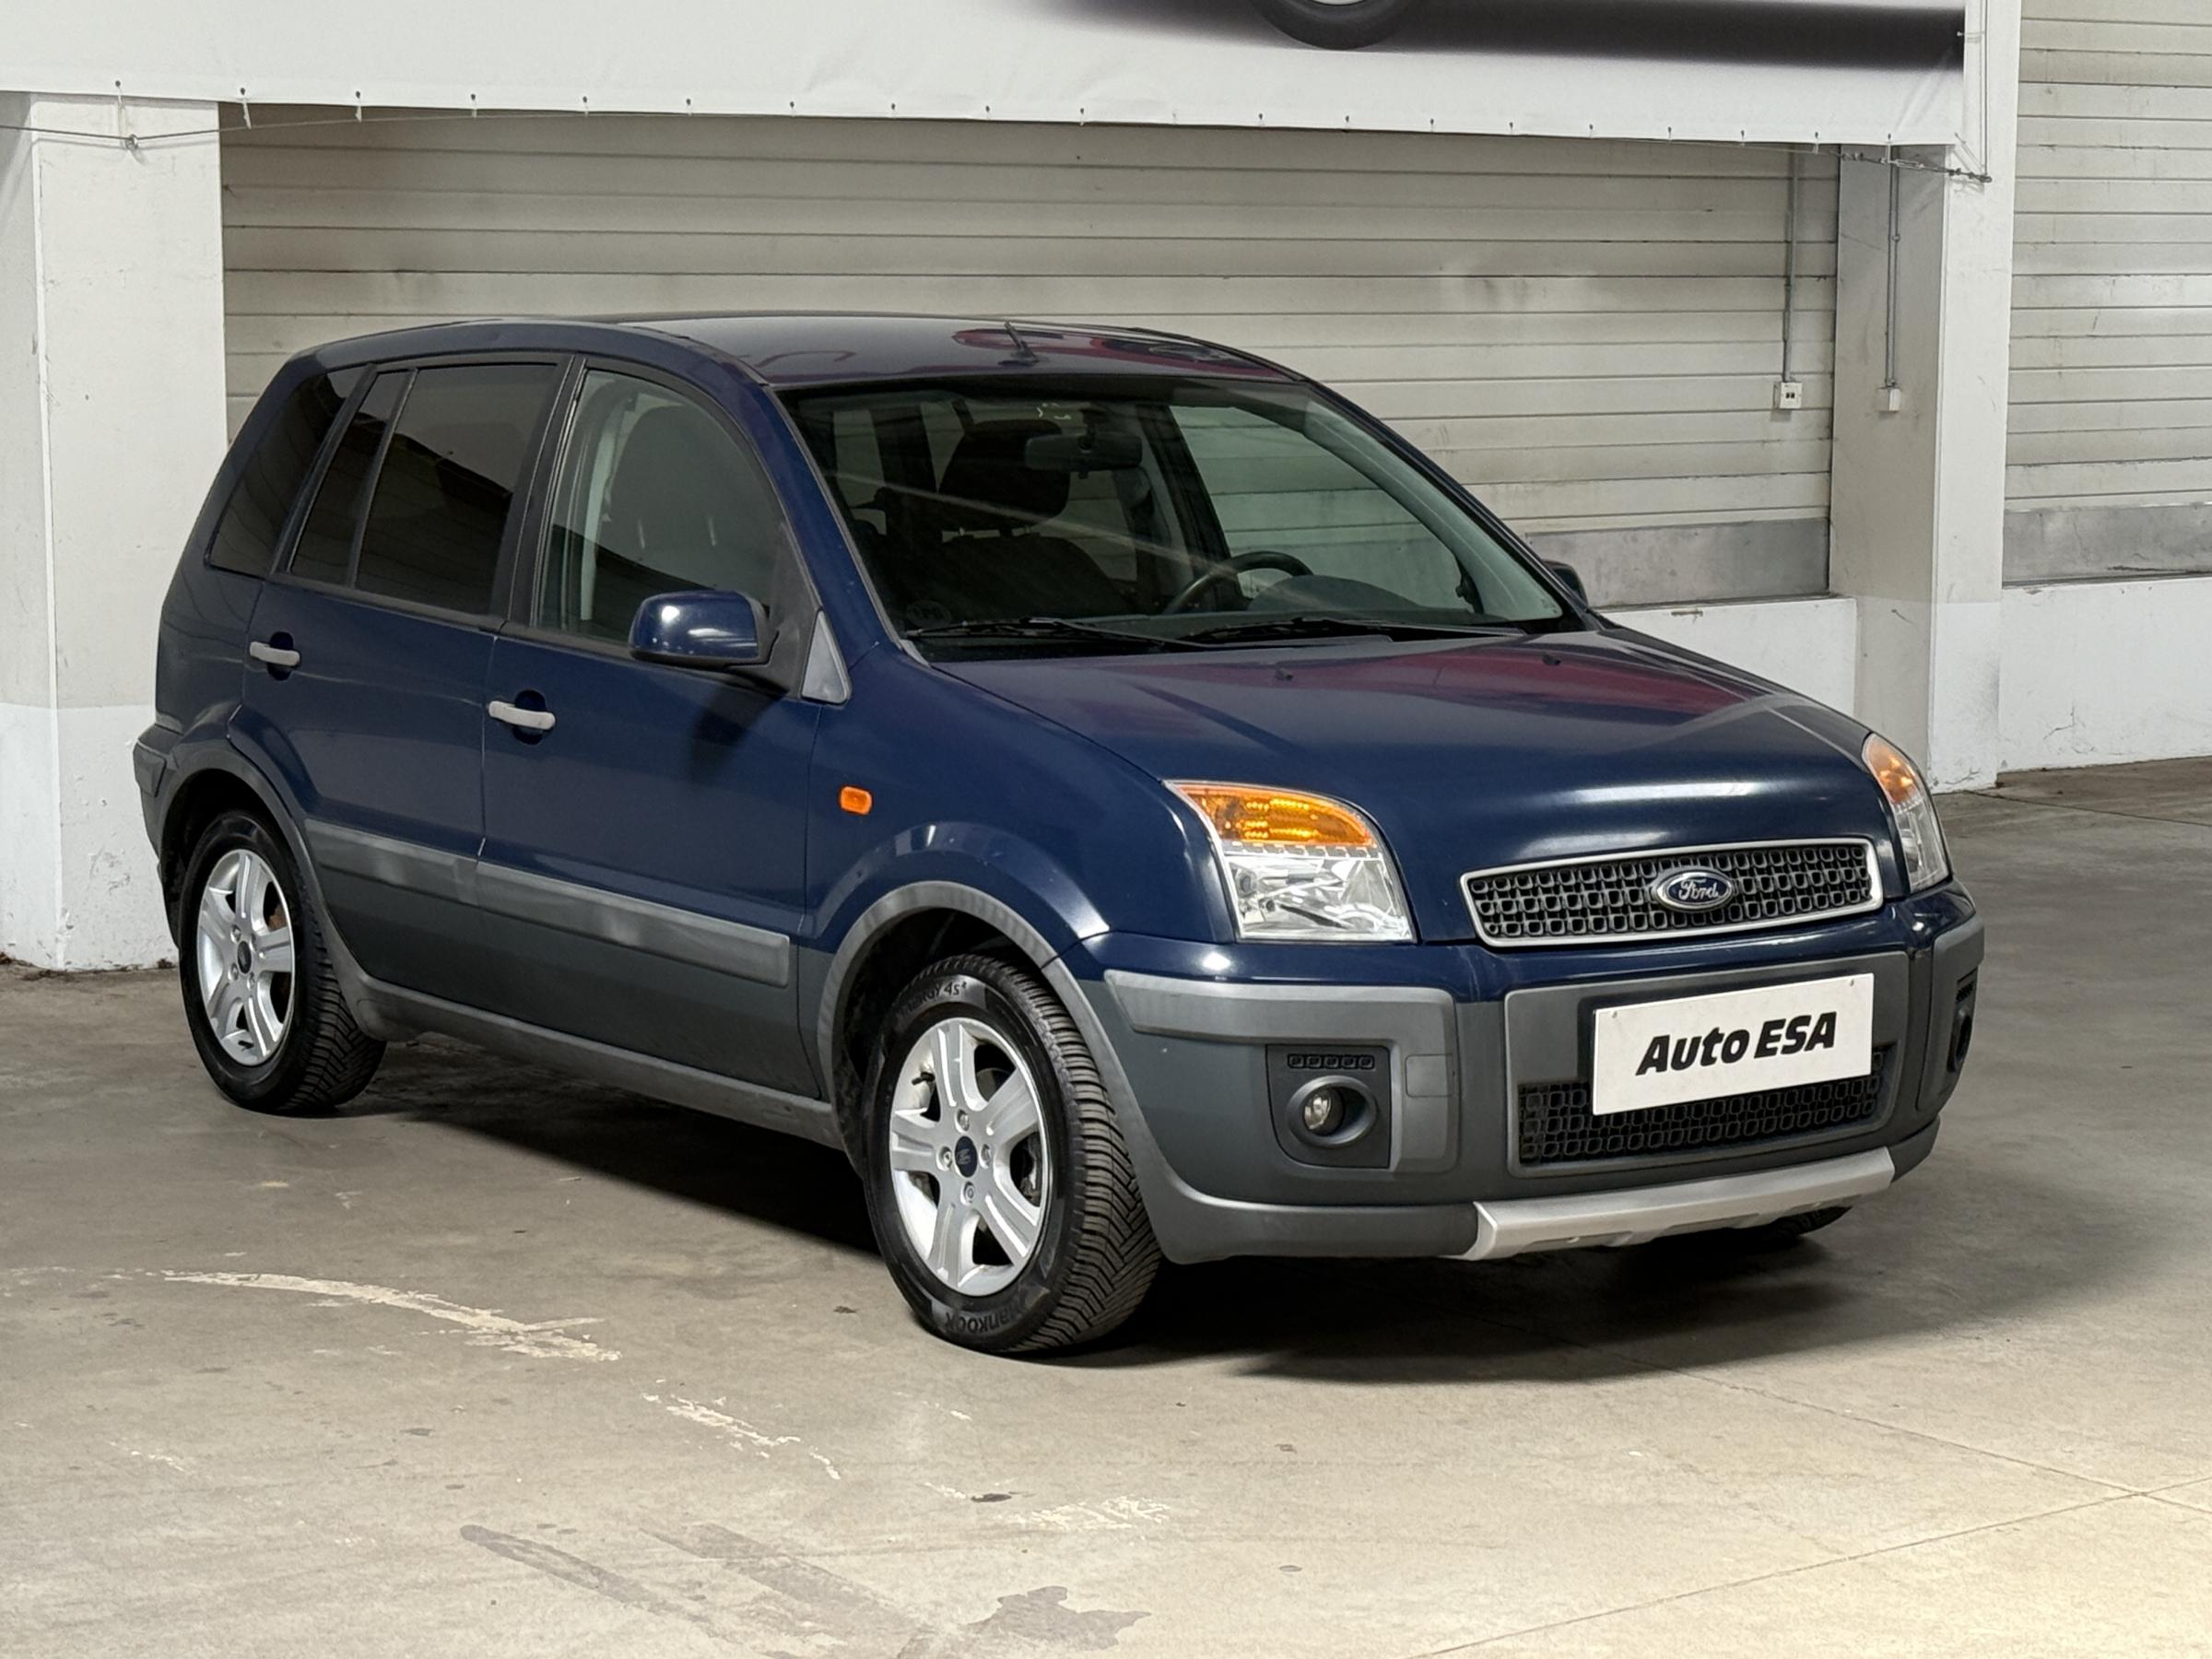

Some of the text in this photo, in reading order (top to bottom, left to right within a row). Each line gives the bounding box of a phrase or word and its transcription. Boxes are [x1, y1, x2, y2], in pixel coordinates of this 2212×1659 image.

[1677, 877, 1720, 900] Ford
[1634, 1011, 1838, 1077] Auto ESA
